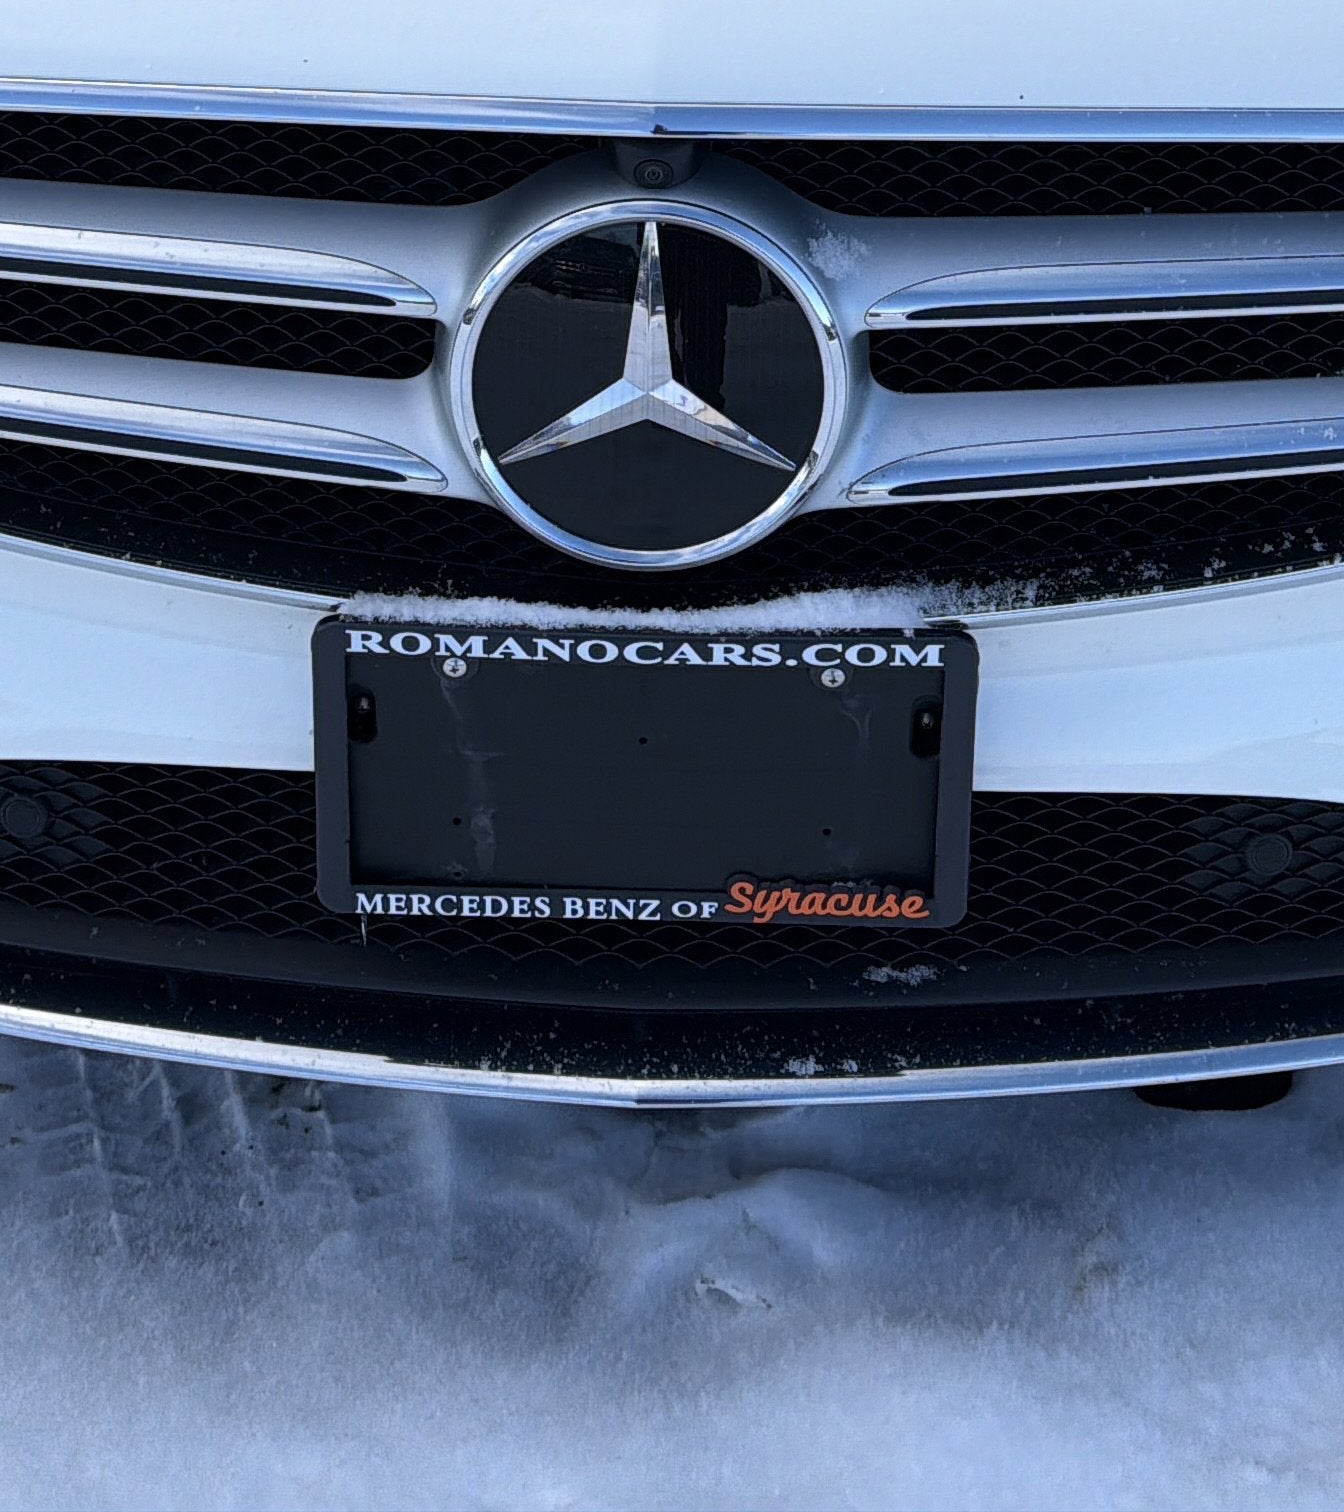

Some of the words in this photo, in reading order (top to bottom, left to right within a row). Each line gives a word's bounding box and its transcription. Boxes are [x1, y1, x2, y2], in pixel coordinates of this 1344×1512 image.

[344, 629, 946, 667] ROMANOCARS.COM
[355, 892, 551, 918] MERCEDES
[562, 897, 661, 921] BENZ
[671, 900, 719, 919] OF
[723, 880, 930, 924] Syracuse
